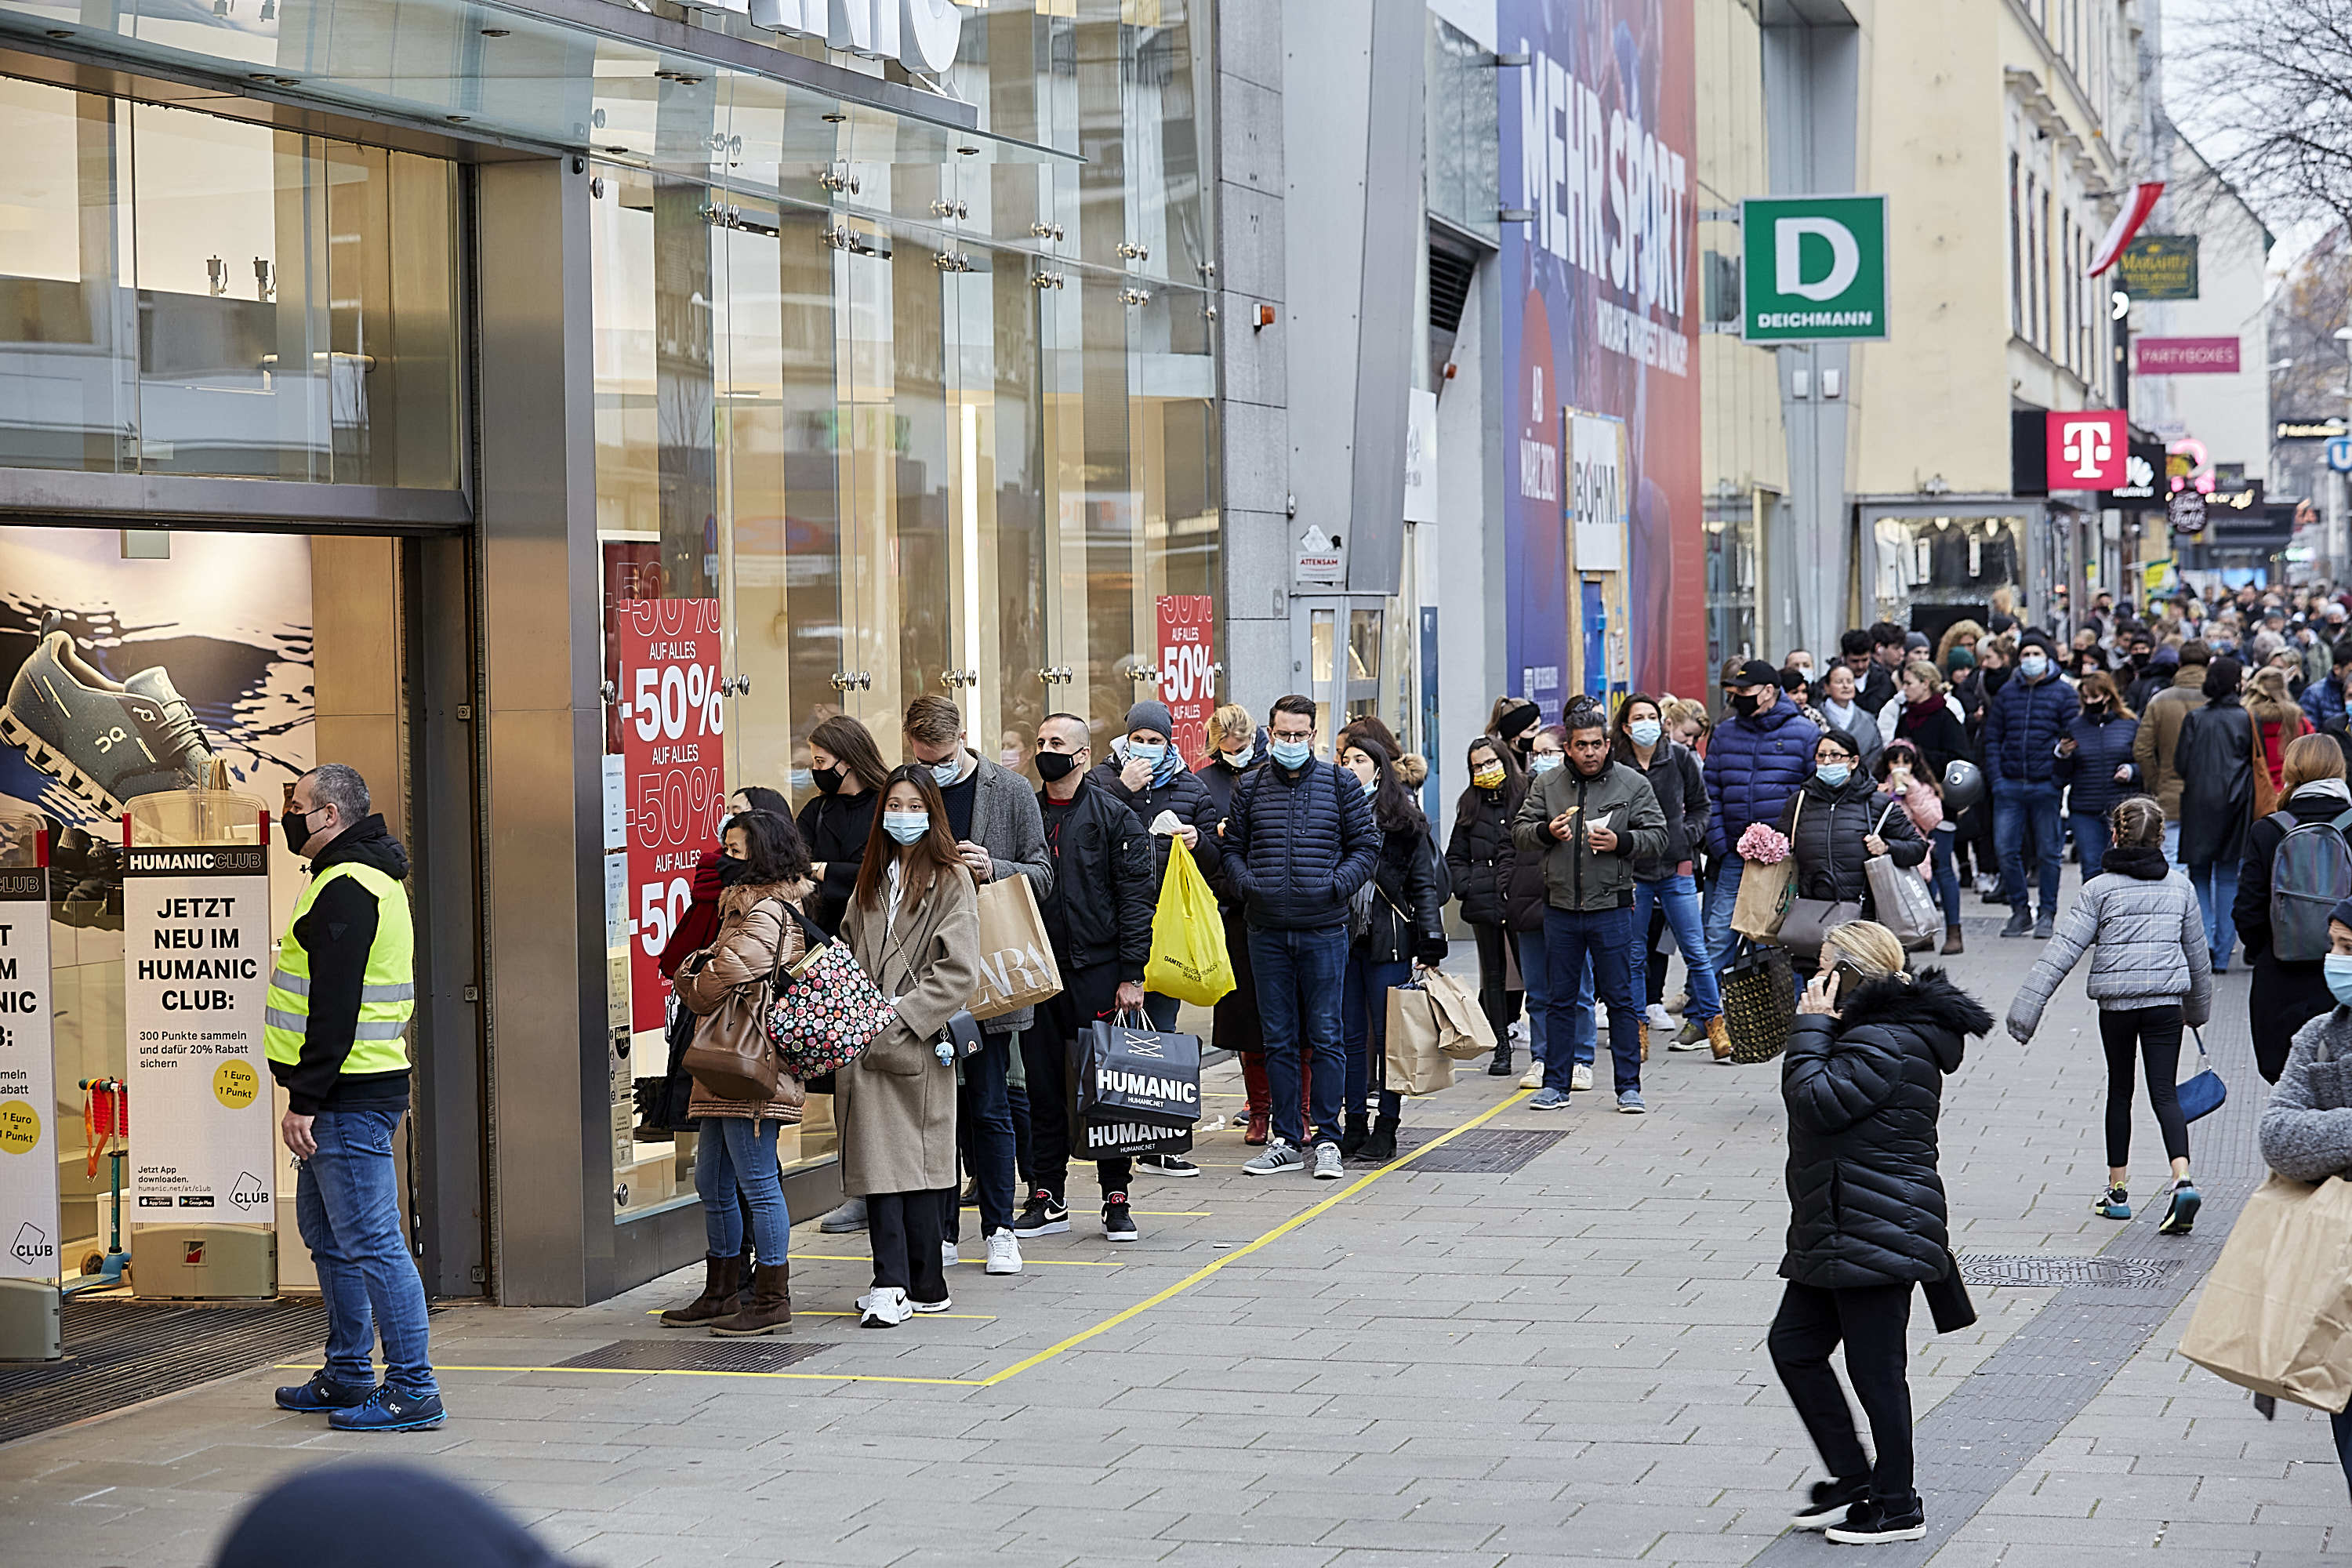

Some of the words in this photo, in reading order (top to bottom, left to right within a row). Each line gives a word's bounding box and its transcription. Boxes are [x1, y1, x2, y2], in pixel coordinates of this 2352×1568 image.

[1521, 38, 1606, 281] MEHR
[1610, 110, 1686, 317] SPORT
[1775, 217, 1860, 301] D
[1758, 311, 1873, 328] DEICHMANN
[2141, 347, 2234, 364] PARTYBOXES
[649, 642, 666, 660] AUF
[669, 641, 696, 659] ALLES
[1157, 644, 1214, 702] -50%
[623, 663, 724, 742] -50%
[652, 747, 670, 765] AUF
[671, 744, 699, 763] ALLES
[626, 767, 724, 848] -50%
[655, 854, 673, 873] AUF
[674, 849, 702, 869] ALLES
[157, 898, 235, 918] JETZT
[154, 929, 203, 949] NEU
[212, 928, 239, 949] IM
[138, 959, 257, 979] HUMANIC
[162, 990, 235, 1011] CLUB:
[140, 1032, 159, 1040] 300
[162, 1031, 198, 1040] Punkte
[201, 1031, 247, 1040] sammeln
[140, 1045, 158, 1054] und
[161, 1044, 187, 1054] dafür
[190, 1045, 212, 1054] 20%
[215, 1045, 249, 1054] Rabatt
[140, 1058, 178, 1068] sichern
[231, 1071, 251, 1081] Euro
[226, 1087, 252, 1098] Punkt
[1098, 1069, 1197, 1103] HUMANIC
[1128, 1097, 1163, 1108] HUMANIC.NET
[3, 1112, 7, 1120] 1
[10, 1113, 31, 1124] Euro
[5, 1131, 33, 1142] Punkt
[1120, 1144, 1155, 1152] HUMANIC.NET
[235, 1192, 269, 1203] CLUB
[16, 1245, 53, 1257] CLUB
